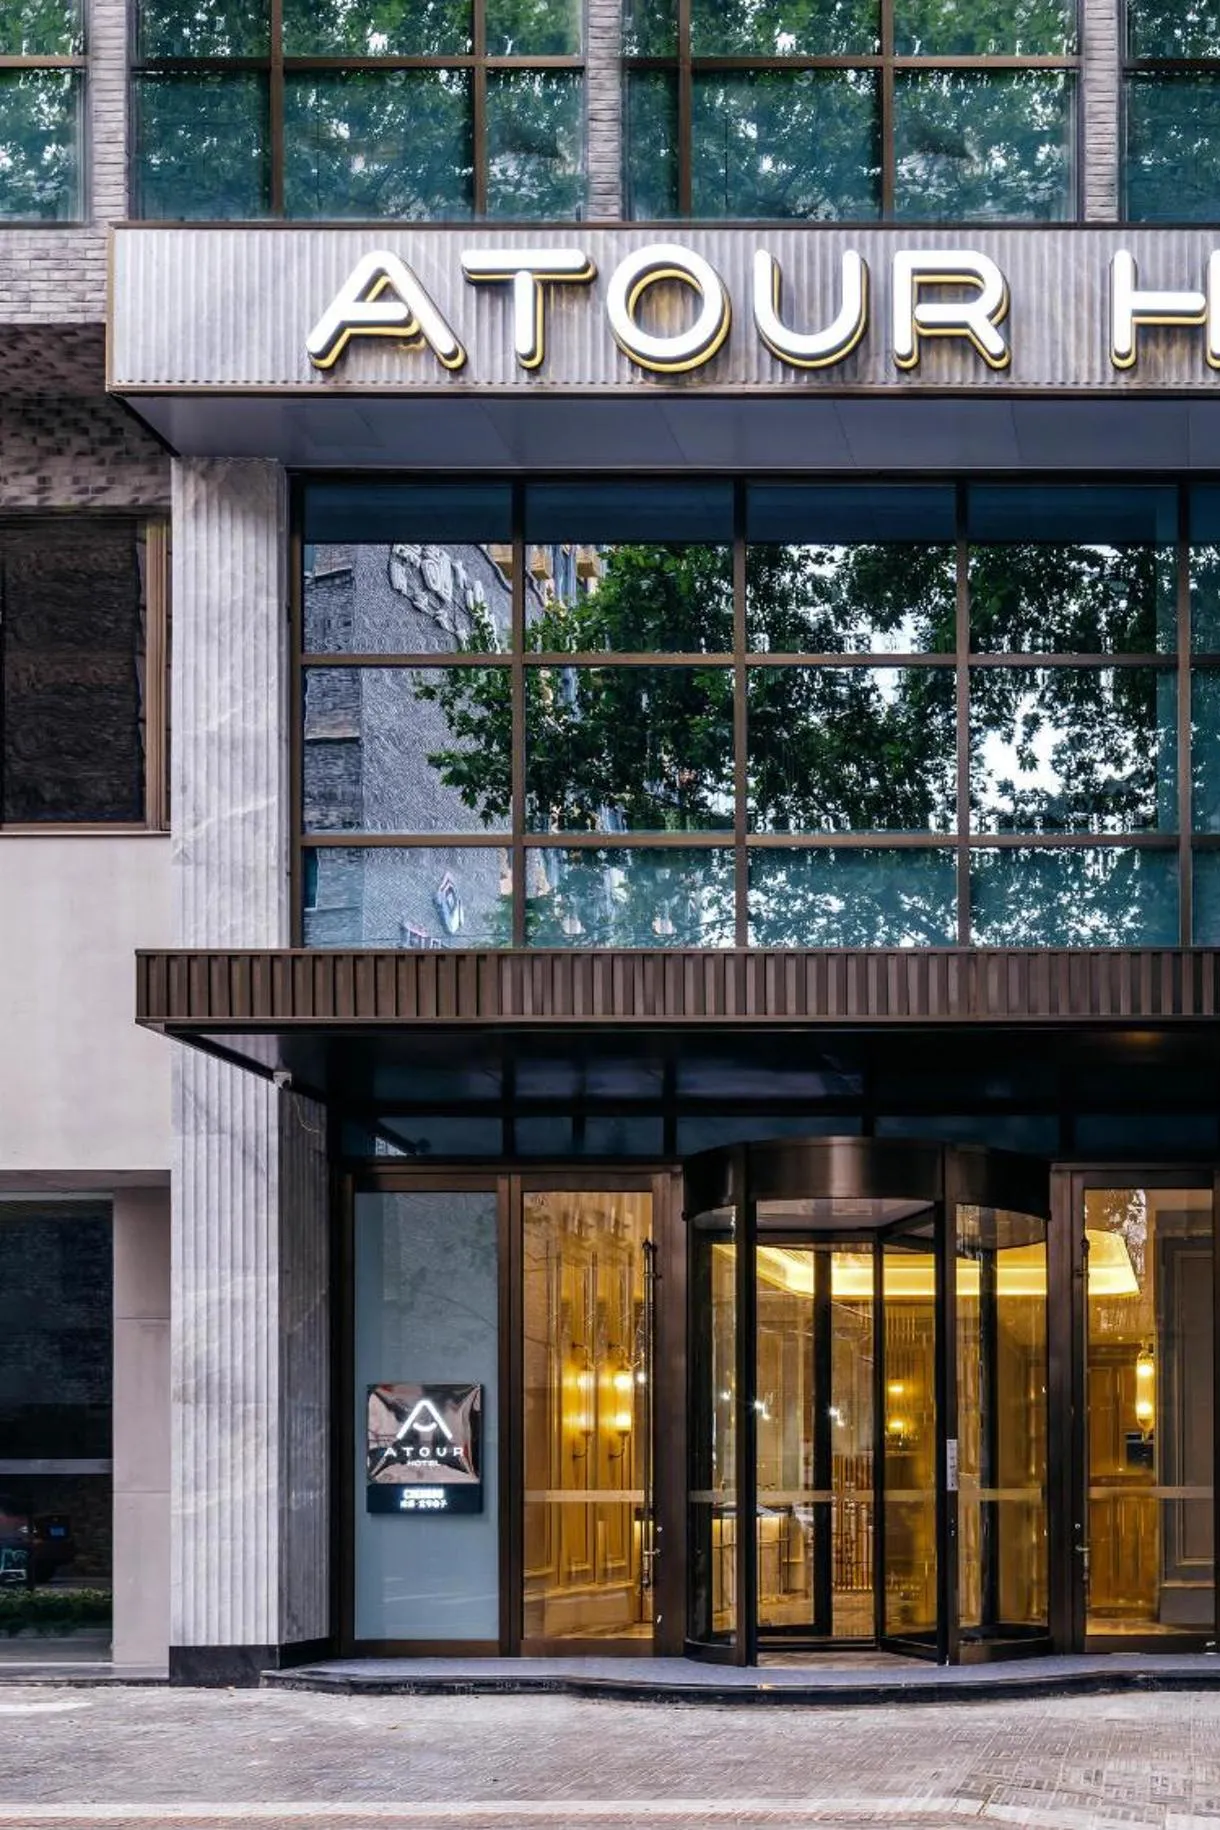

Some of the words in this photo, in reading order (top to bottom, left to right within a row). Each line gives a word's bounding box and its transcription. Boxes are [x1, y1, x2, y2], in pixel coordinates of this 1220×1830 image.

[305, 244, 1010, 371] ATOUR
[384, 1447, 464, 1457] ATOUR
[406, 1459, 441, 1467] HOTEL
